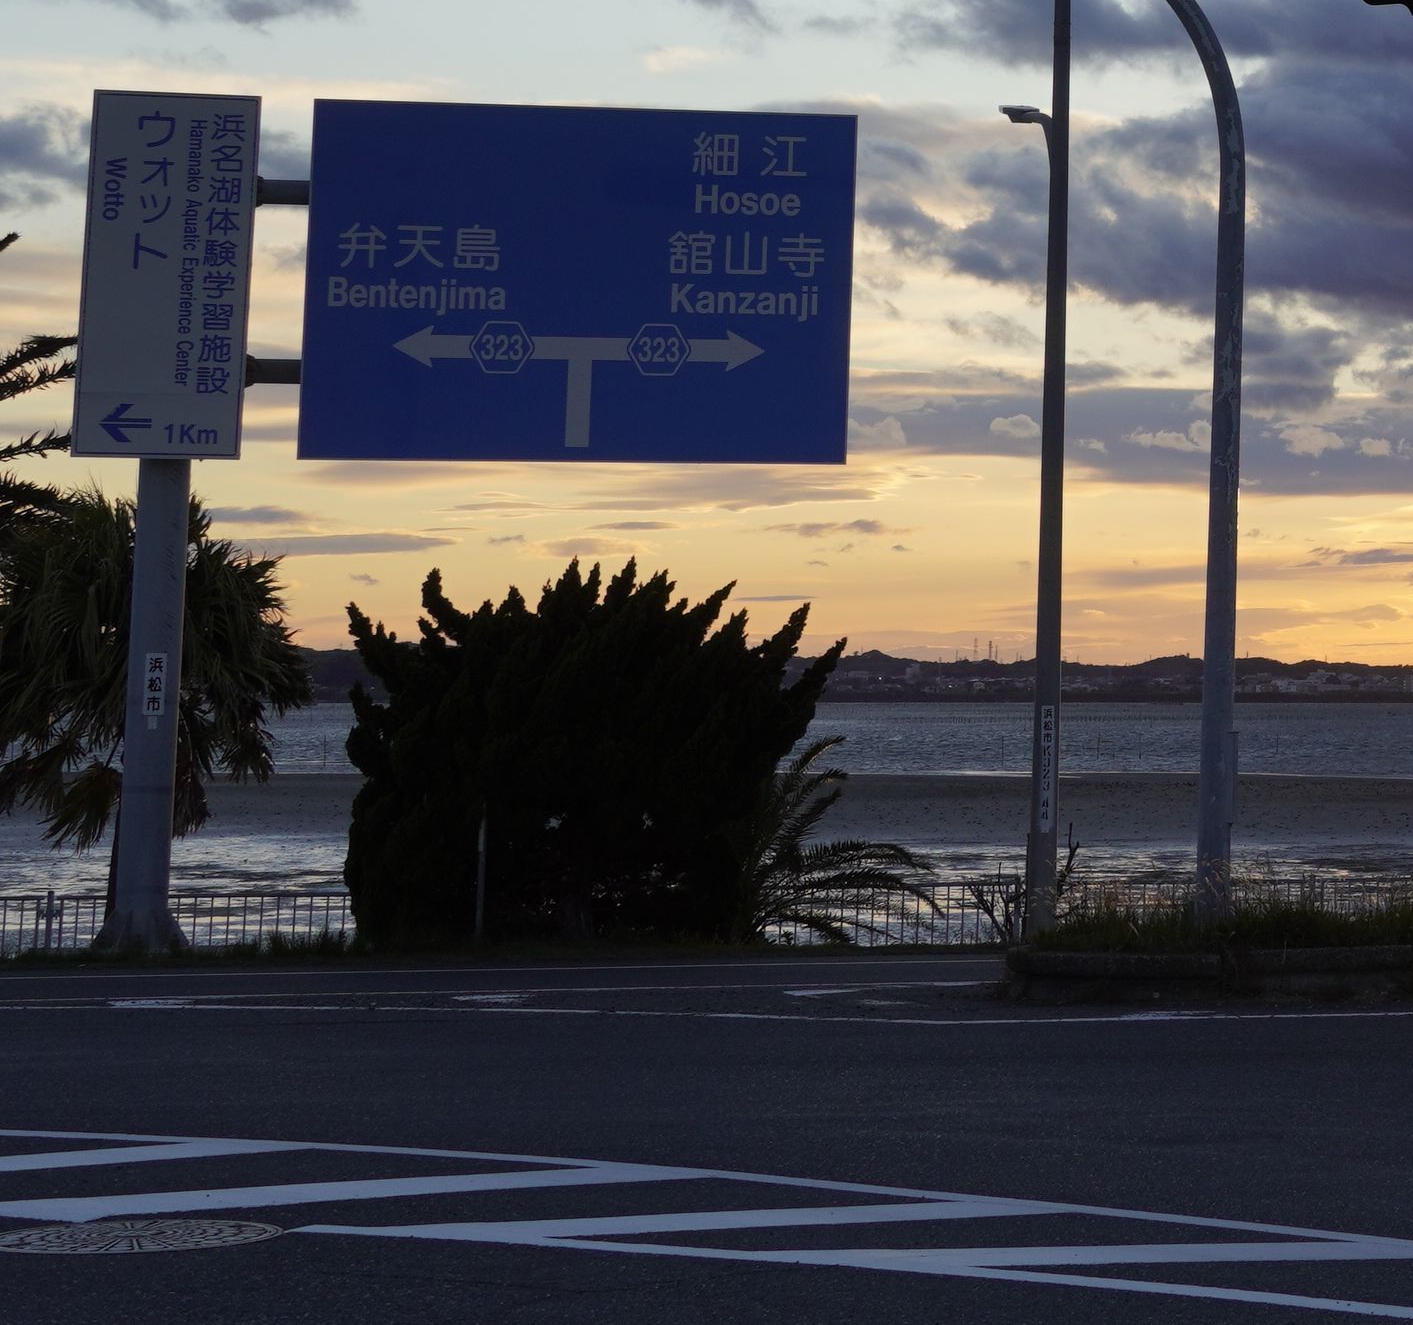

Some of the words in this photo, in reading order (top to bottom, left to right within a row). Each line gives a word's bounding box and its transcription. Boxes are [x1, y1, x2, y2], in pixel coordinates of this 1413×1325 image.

[187, 119, 208, 193] Hamanako
[692, 132, 808, 178] 細江
[102, 157, 128, 221] Wotto
[695, 185, 801, 217] Hosoe
[181, 199, 203, 251] Aquatic
[338, 223, 501, 272] 弁天島
[196, 113, 246, 395] 浜名湖体験学習施設
[668, 231, 825, 278] 舘山寺
[177, 258, 199, 334] Experience
[328, 276, 506, 315] Bentenjima
[670, 282, 819, 322] Kanzanji
[174, 341, 194, 386] Center
[480, 333, 523, 363] 323
[638, 335, 680, 365] 323
[164, 424, 218, 445] 1Km
[147, 657, 164, 711] 浜松市
